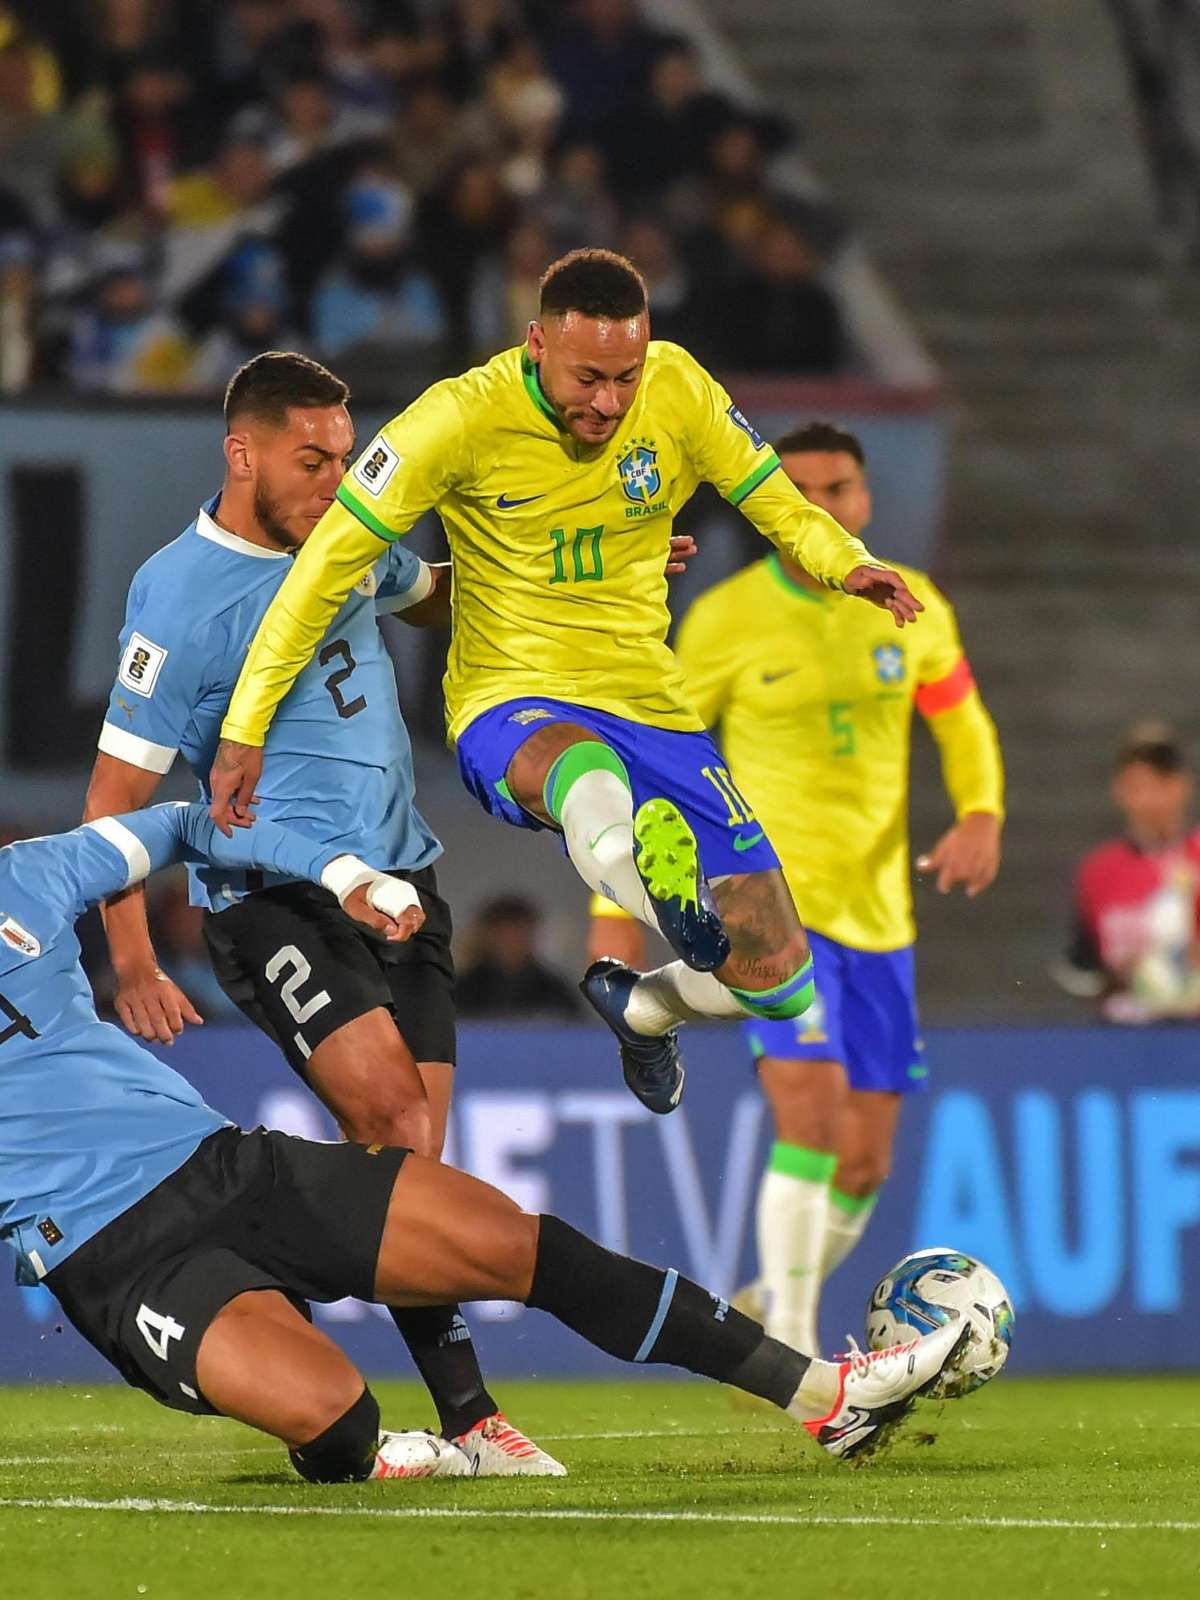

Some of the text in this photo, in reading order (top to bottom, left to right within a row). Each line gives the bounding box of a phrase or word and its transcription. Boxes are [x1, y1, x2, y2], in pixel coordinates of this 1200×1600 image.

[631, 467, 647, 479] CBF
[625, 501, 668, 518] BRASIL
[549, 524, 604, 585] 10
[318, 638, 368, 719] 2
[827, 702, 856, 756] 5
[265, 944, 333, 1025] 2
[135, 1303, 187, 1362] 4
